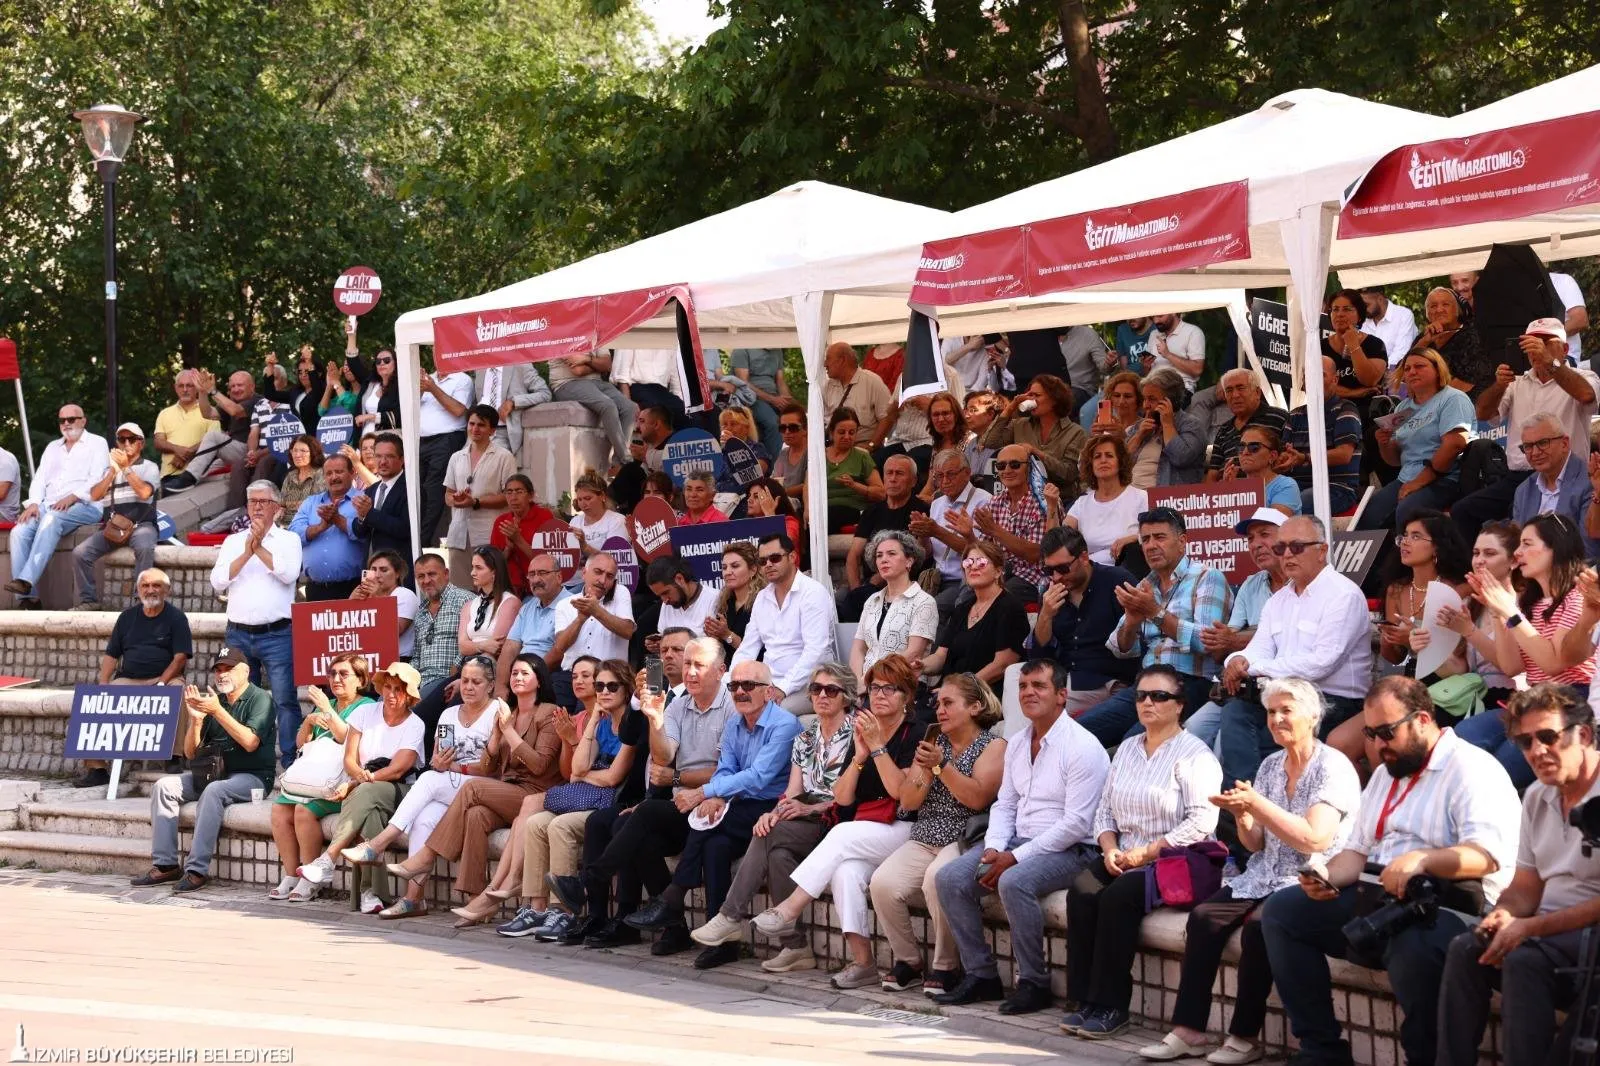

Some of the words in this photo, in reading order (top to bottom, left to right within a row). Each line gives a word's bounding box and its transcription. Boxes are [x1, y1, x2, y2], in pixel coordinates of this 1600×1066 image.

[1415, 156, 1459, 189] EĞİTİM
[1458, 151, 1512, 178] MARATONU
[1090, 222, 1128, 250] EĞİTİM
[1127, 216, 1169, 240] MARATONU
[919, 255, 957, 270] ARATONU
[346, 272, 371, 288] LAİK
[339, 290, 373, 305] eğitim
[269, 423, 300, 436] ENGELSİZ
[321, 429, 347, 444] eğitim
[668, 441, 716, 459] BİLİMSEL
[1212, 491, 1257, 508] sınırının
[1214, 510, 1240, 529] değil
[542, 529, 568, 549] LAİK
[642, 519, 667, 544] EĞİTİM
[311, 609, 377, 631] MÜLAKAT
[328, 631, 363, 652] DEĞİL
[80, 692, 170, 715] MÜLAKATA
[76, 722, 165, 752] HAYIR!
